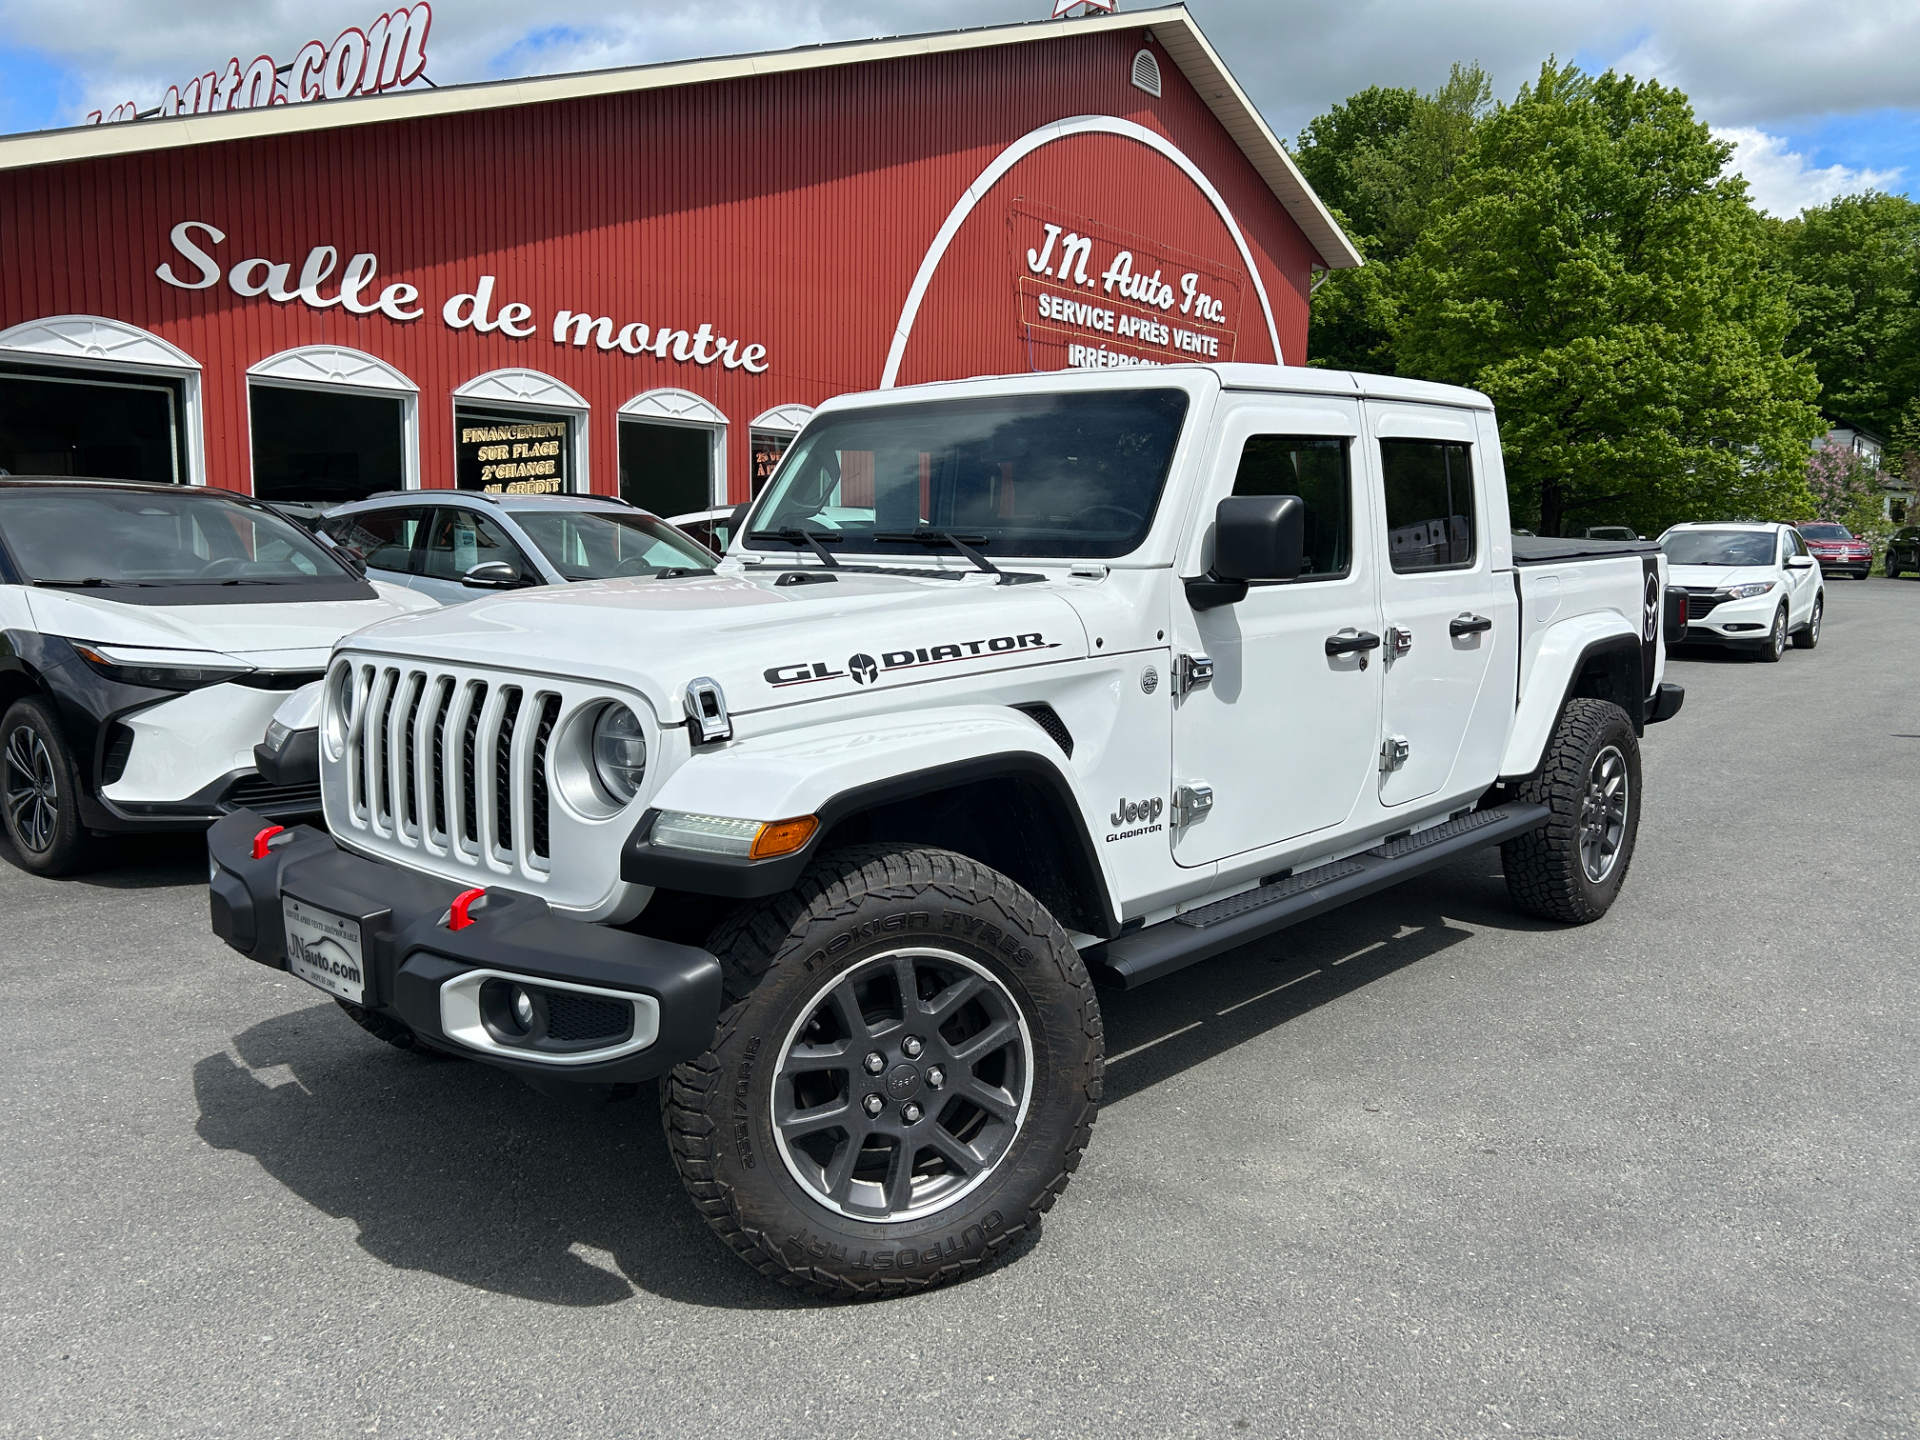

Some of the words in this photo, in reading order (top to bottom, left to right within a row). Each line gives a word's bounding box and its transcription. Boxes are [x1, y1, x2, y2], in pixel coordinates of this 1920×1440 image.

[1027, 223, 1096, 288] J.N.
[1101, 250, 1176, 311] Auto
[1179, 272, 1227, 324] Inc.
[155, 221, 425, 320] Salle
[442, 275, 537, 337] de
[553, 310, 770, 373] montre
[1038, 293, 1115, 333] SERVICE
[1117, 316, 1170, 346] APRÈS
[1172, 327, 1219, 358] VENTE
[461, 422, 566, 443] FINANCEMENT
[478, 444, 509, 461] SUR
[512, 441, 559, 459] PLACE
[495, 460, 555, 479] CHANCE
[506, 478, 561, 495] CRÉDIT
[1111, 797, 1163, 828] Jeep
[1106, 823, 1162, 843] GLADIATOR
[941, 908, 1035, 967] TYRES
[851, 1208, 1006, 1271] OUTPOST
